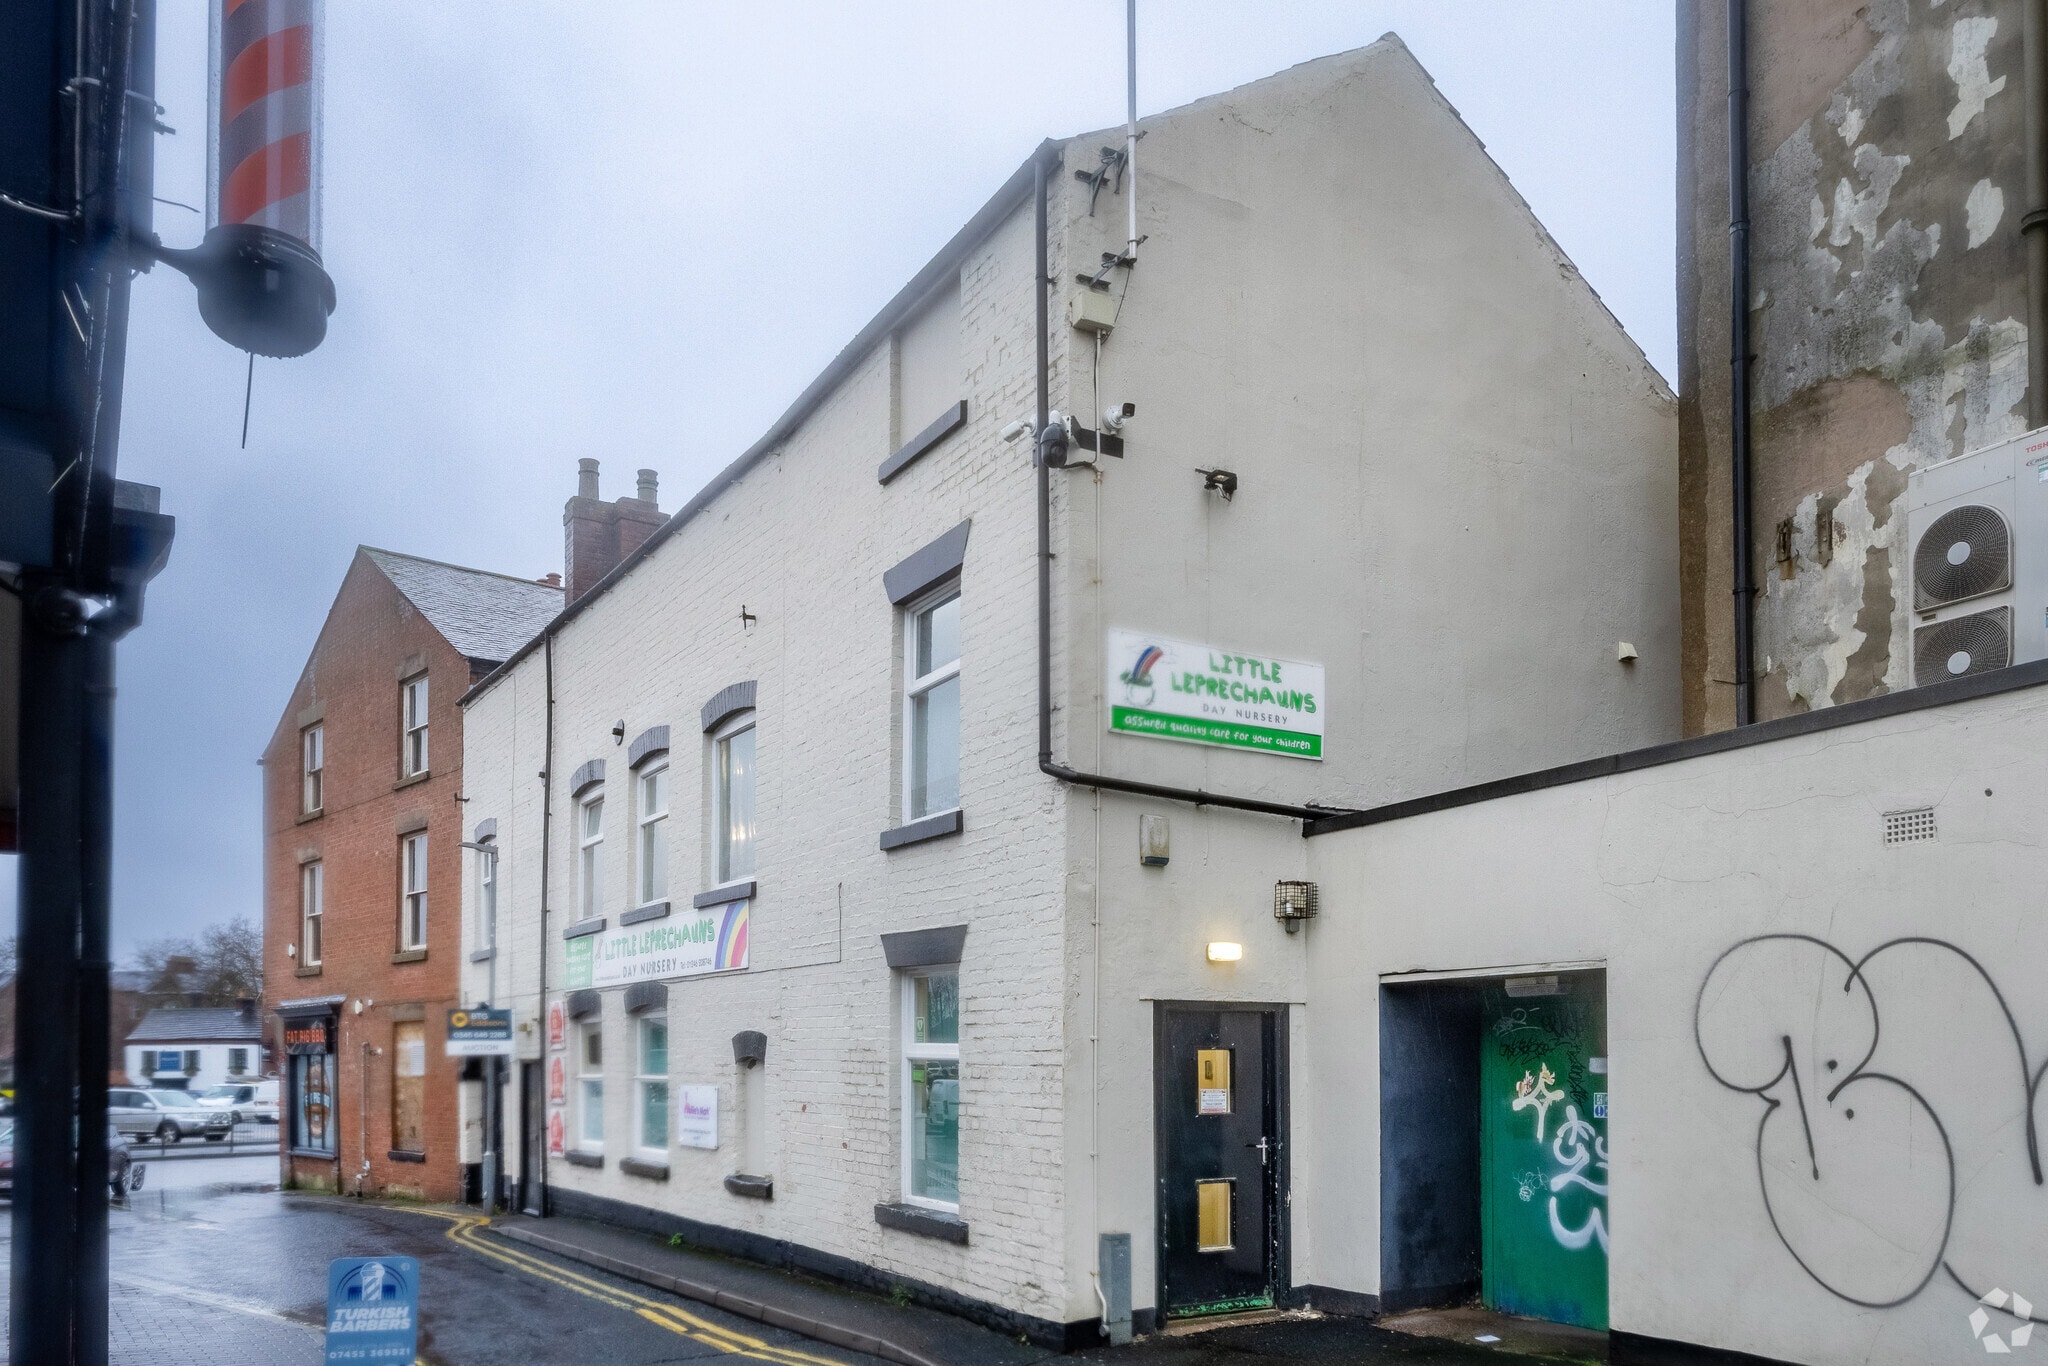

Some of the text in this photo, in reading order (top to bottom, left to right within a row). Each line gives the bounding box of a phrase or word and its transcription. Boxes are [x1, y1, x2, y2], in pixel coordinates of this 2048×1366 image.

[1209, 652, 1282, 684] LITTLE
[1171, 671, 1317, 713] LEPRECHAUNS
[1202, 703, 1288, 725] DAY NURSERY
[1124, 715, 1167, 730] assured
[1209, 728, 1230, 740] care
[1233, 730, 1250, 741] for
[1252, 733, 1273, 745] your
[1275, 737, 1311, 751] children
[605, 918, 715, 961] LITTLE LEPRECHAUNS
[622, 964, 637, 979] DAY
[640, 957, 678, 977] NURSERY
[470, 1012, 489, 1020] BTG
[286, 1030, 298, 1044] FAT
[335, 1306, 409, 1321] TURKISH
[329, 1318, 411, 1333] BARBERS
